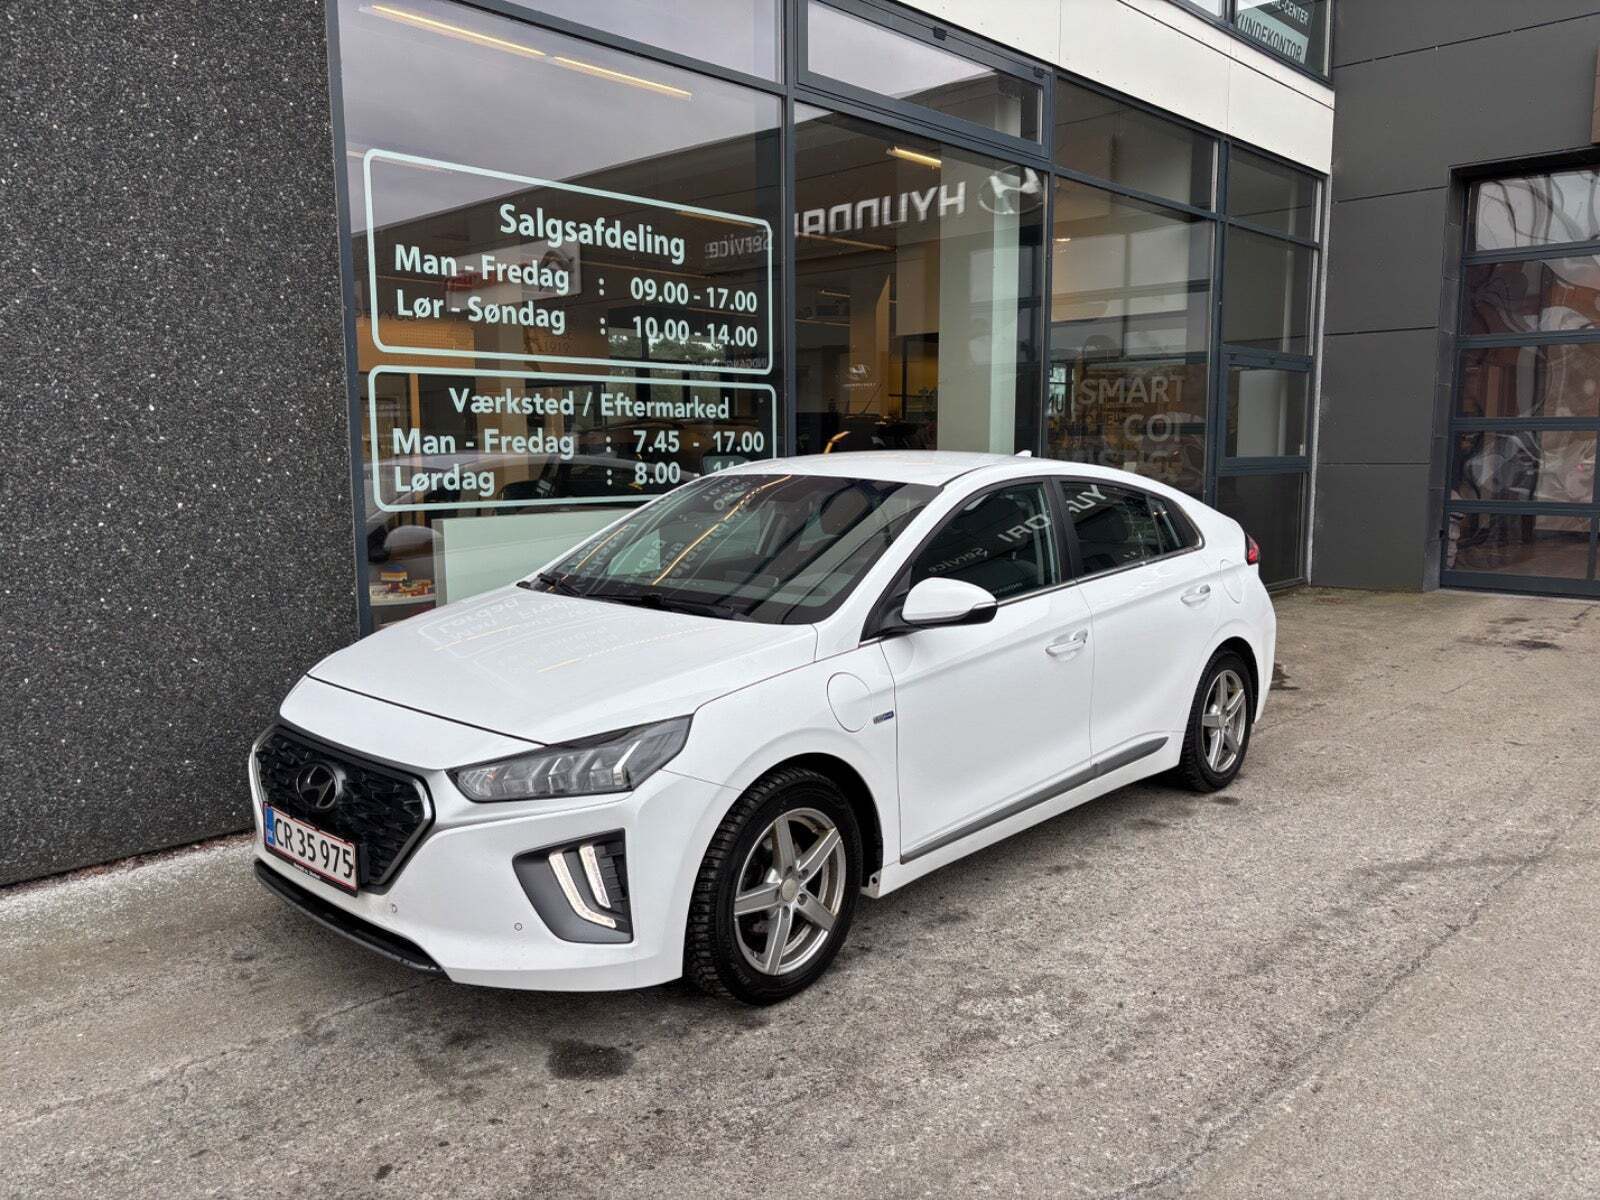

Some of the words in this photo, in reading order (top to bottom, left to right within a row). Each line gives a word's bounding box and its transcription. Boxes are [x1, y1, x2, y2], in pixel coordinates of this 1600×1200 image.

[500, 203, 686, 265] Salgsafdeling
[395, 244, 457, 277] Man
[481, 254, 569, 296] Fredag
[630, 276, 689, 304] 09.00
[706, 286, 757, 312] 17.00
[396, 289, 444, 318] Lør
[467, 295, 566, 336] Søndag
[632, 315, 690, 342] 10.00
[706, 323, 758, 347] 14.00
[448, 387, 574, 415] Værksted
[582, 391, 592, 417] /
[601, 392, 729, 419] Eftermarked
[1078, 375, 1186, 405] SMART
[392, 427, 456, 455] Man
[484, 427, 575, 460] Fredag
[633, 430, 680, 452] 7.45
[712, 431, 764, 452] 17.00
[395, 464, 494, 497] Lørdag
[634, 461, 681, 485] 8.00
[275, 818, 294, 853] CR
[296, 829, 316, 862] 35
[320, 840, 353, 879] 975
